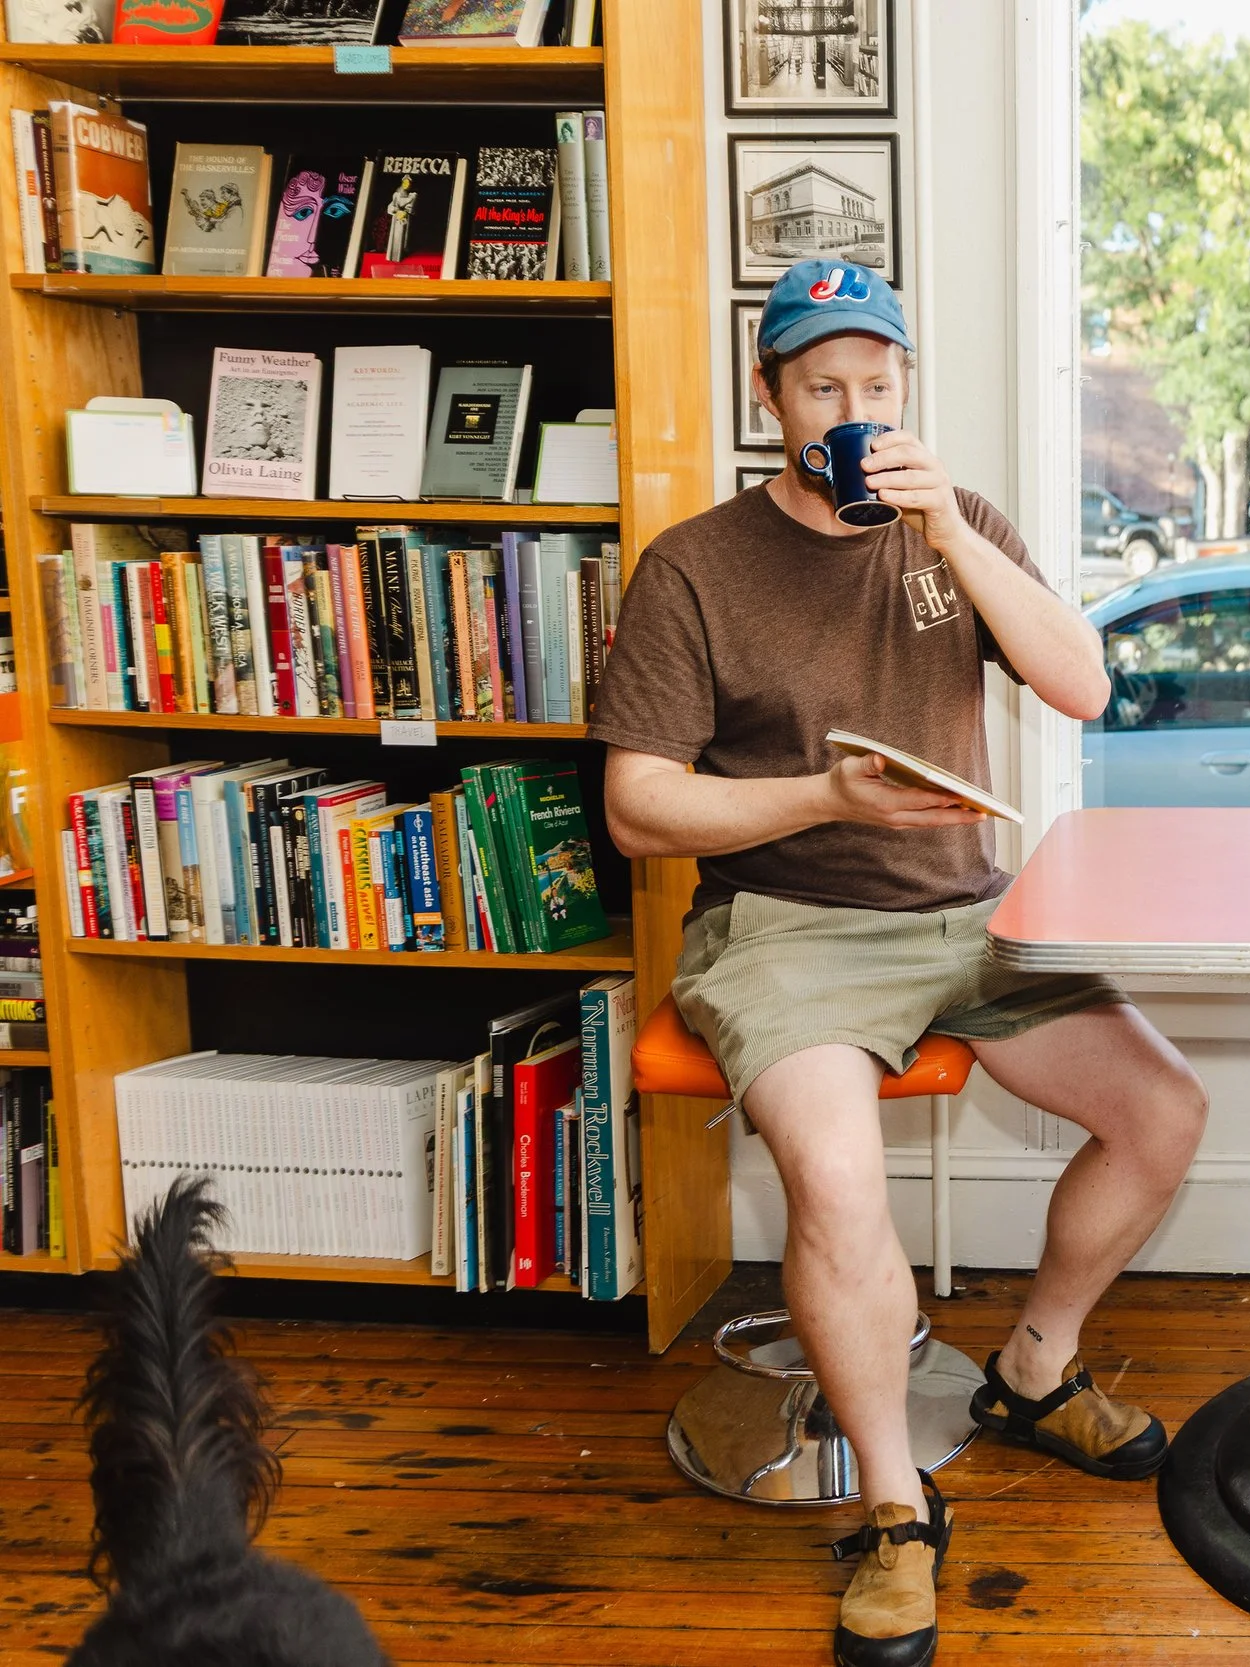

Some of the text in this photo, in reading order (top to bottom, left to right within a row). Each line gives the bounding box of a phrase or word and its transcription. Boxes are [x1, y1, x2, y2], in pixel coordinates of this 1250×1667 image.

[76, 118, 144, 161] COBWEB
[189, 155, 204, 163] THE
[206, 156, 234, 164] HOUND
[197, 164, 256, 173] BASKERVILLES
[383, 156, 451, 175] REBECCA
[338, 172, 358, 183] Oscar
[338, 183, 356, 194] Wilde
[475, 207, 544, 225] All the King's Men
[276, 231, 299, 242] Picture
[219, 352, 311, 368] Funny Weather
[261, 368, 298, 376] Emergency
[208, 462, 302, 482] Olivia Laing
[206, 541, 220, 567] THE
[208, 571, 227, 611] WALK
[359, 542, 374, 610] MASSACHUSETTS
[227, 544, 247, 667] A WALK ACROSS AMERICA
[330, 556, 347, 656] NEW HAMPSHIRE BEAUTIFUL
[345, 552, 360, 641] VERMONT BEAUTIFUL
[385, 550, 404, 640] MAINE Beautiful
[413, 588, 423, 615] BRAZILIAN
[918, 573, 948, 619] H
[943, 588, 957, 604] M
[83, 596, 99, 684] IMAGINED CORNERS
[214, 615, 229, 653] WEST
[416, 616, 425, 641] JOURNAL
[592, 636, 598, 647] OF
[276, 772, 327, 803] EPIC
[530, 805, 581, 821] French Riviera
[411, 836, 416, 844] on
[437, 803, 451, 879] EL SALVADOR
[412, 849, 420, 880] shoestring
[418, 836, 434, 907] southeast asia
[479, 848, 489, 877] MICHELIN
[529, 846, 538, 875] MICHELIN
[354, 828, 374, 926] CATSKILLS ALIVE!
[345, 874, 355, 917] EXPLORING
[580, 1000, 611, 1215] Norman Rockwell
[520, 1134, 531, 1217] Charles Biederman
